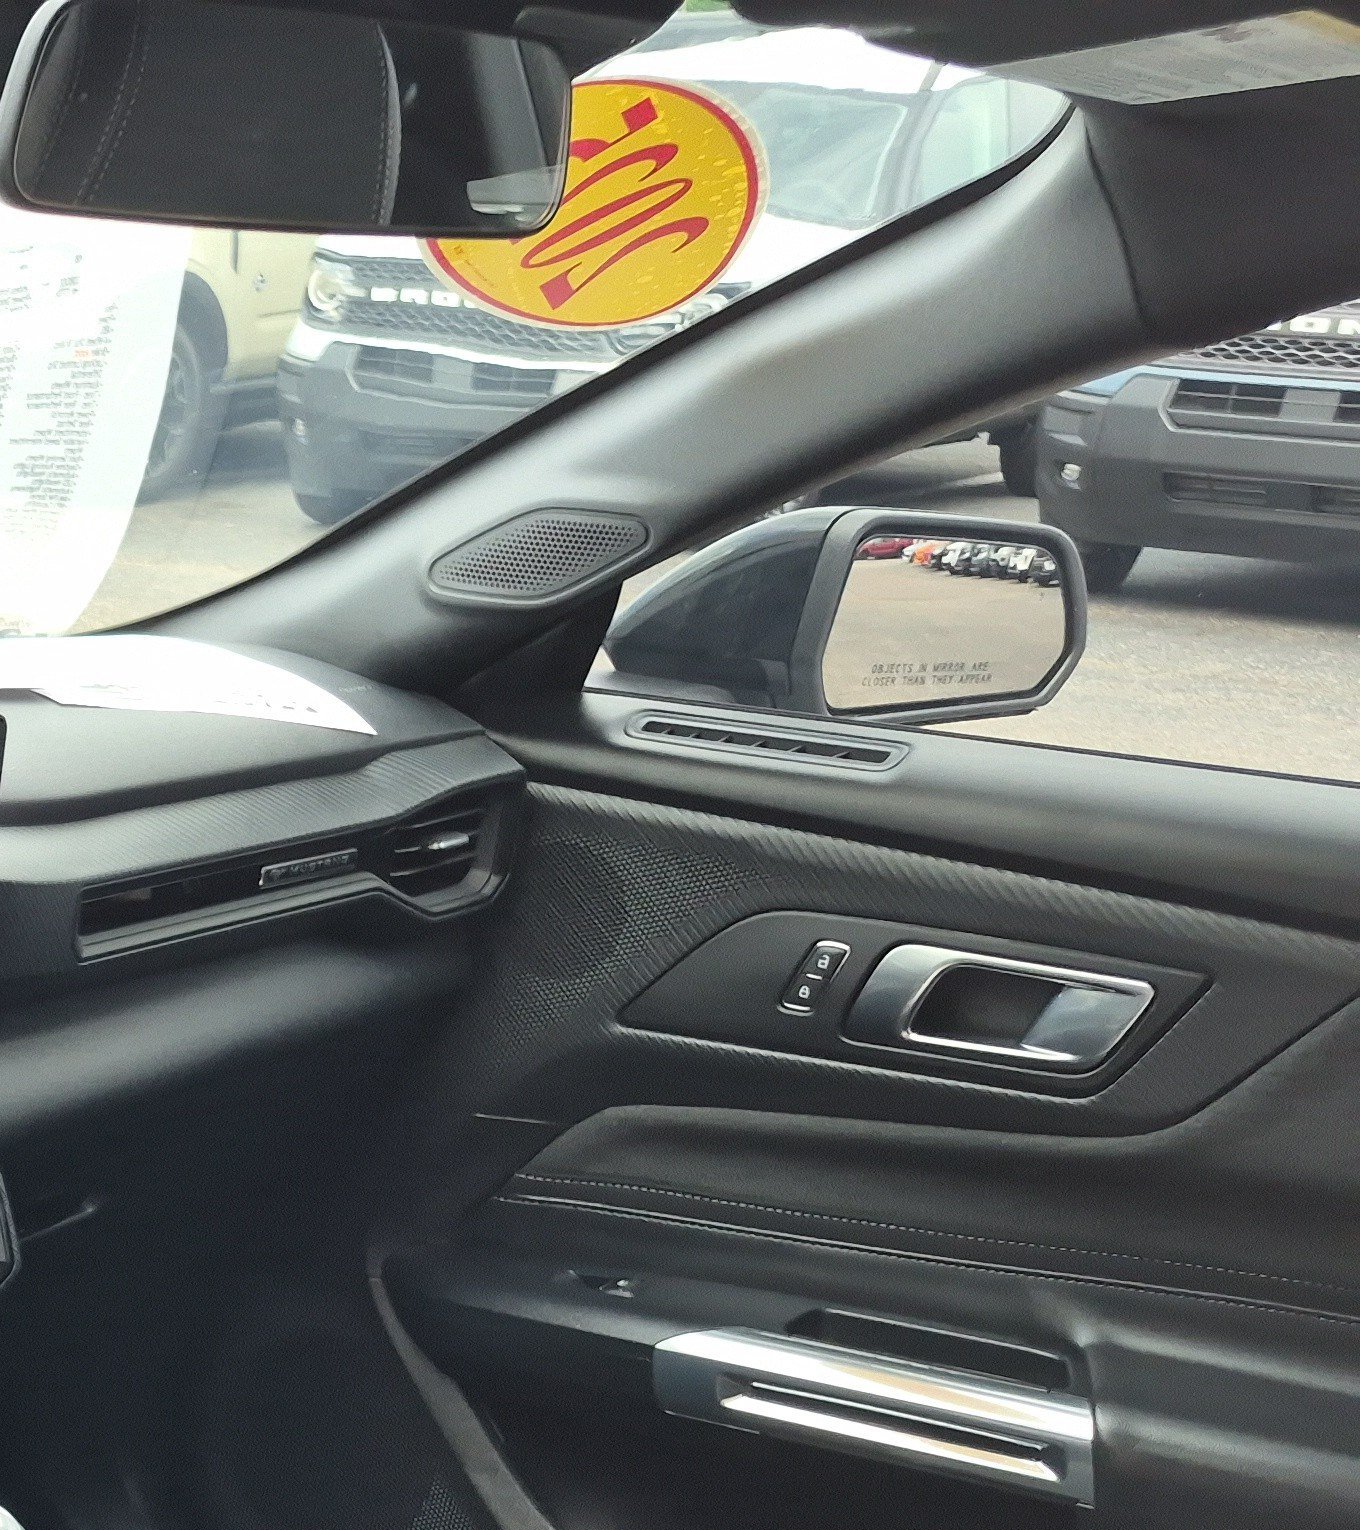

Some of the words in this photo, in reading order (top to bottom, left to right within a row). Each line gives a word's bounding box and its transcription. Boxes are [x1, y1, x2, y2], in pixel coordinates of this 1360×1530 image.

[871, 663, 913, 674] OBJECTS
[933, 662, 966, 673] MIRROR
[971, 661, 989, 672] ARE
[861, 676, 896, 687] CLOSER
[902, 675, 927, 686] THAN
[932, 674, 954, 685] THEY
[958, 673, 993, 684] APPEAR
